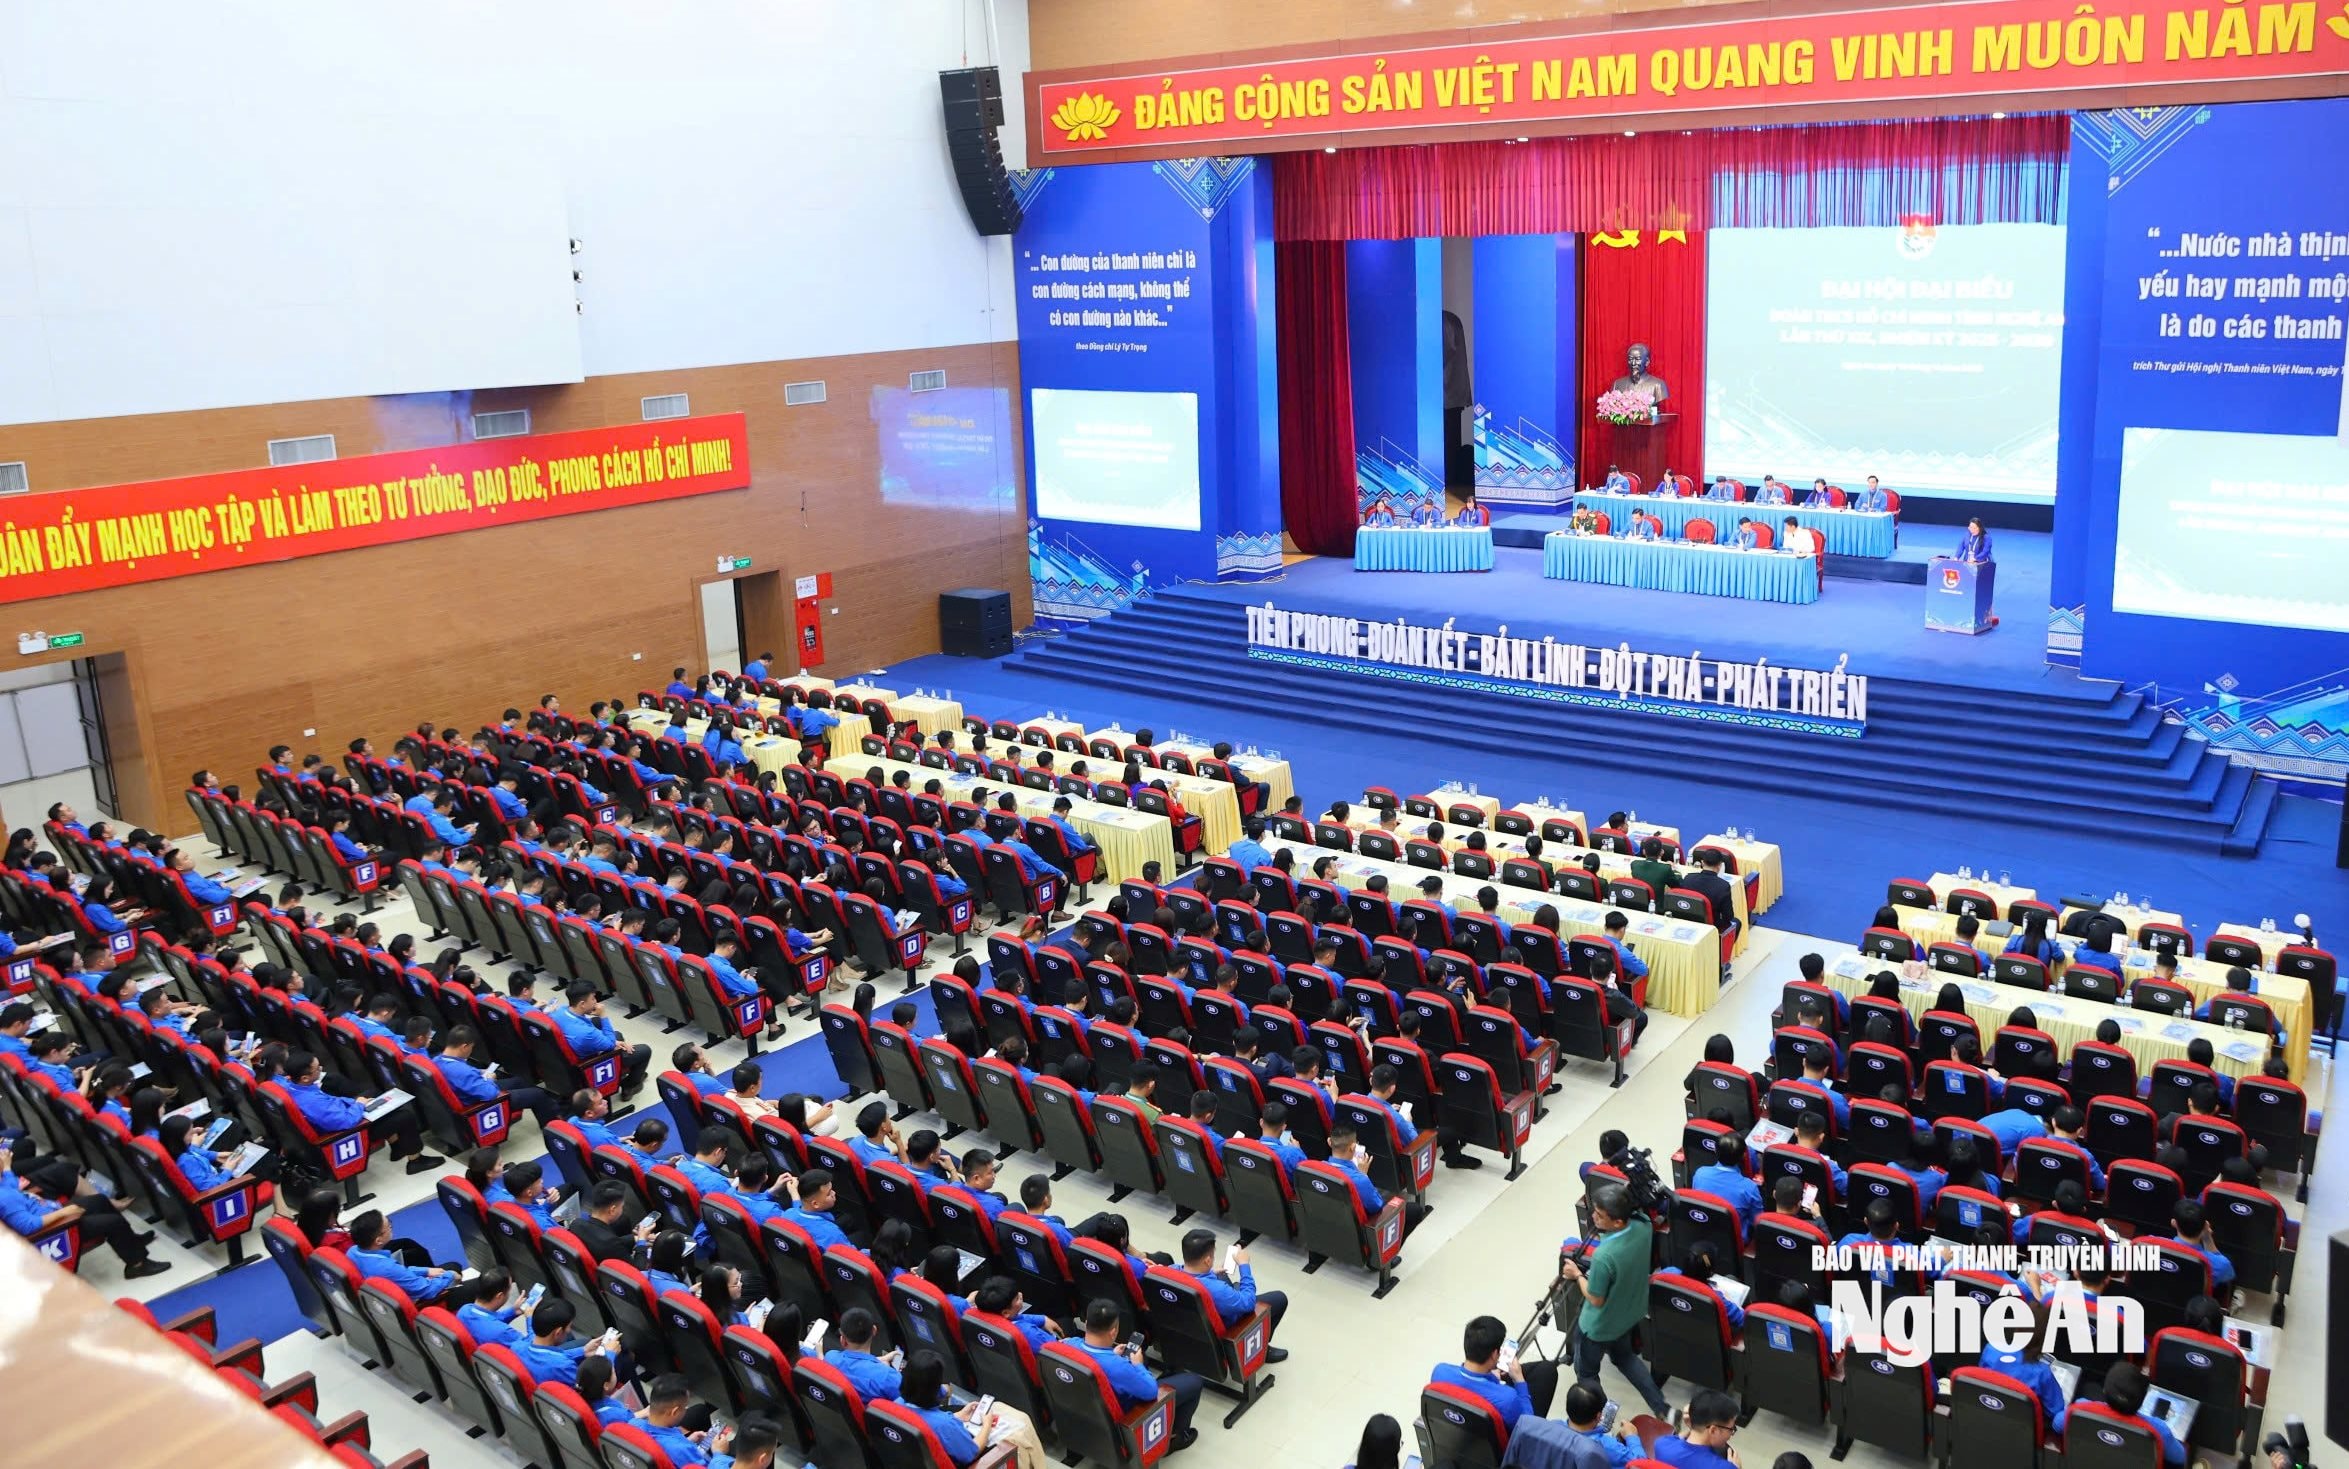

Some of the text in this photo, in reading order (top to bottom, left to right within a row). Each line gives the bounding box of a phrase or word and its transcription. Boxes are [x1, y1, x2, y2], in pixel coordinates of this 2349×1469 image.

[1134, 0, 2315, 130] ĐẢNG CỘNG SẢN VIỆT NAM QUANG VINH MUÔN NĂM
[2247, 232, 2292, 257] nhà
[2300, 232, 2349, 262] thịn
[1040, 254, 1059, 272] Con
[1060, 254, 1090, 272] đường
[1092, 252, 1110, 270] của
[1112, 253, 1140, 270] thanh
[1142, 252, 1164, 270] niên
[1167, 249, 1183, 269] chỉ
[1186, 251, 1196, 269] là
[1032, 284, 1050, 299] con
[1051, 282, 1080, 300] đường
[1082, 282, 1105, 298] cách
[1140, 281, 1171, 299] không
[1173, 277, 1191, 298] thể
[2138, 269, 2349, 303] yếu hay mạnh mộ
[1049, 309, 1062, 326] có
[1063, 312, 1080, 326] con
[1082, 310, 1111, 328] đường
[1114, 310, 1132, 326] nào
[2159, 313, 2342, 339] là do các thanh
[2223, 363, 2250, 373] Thanh
[2251, 363, 2270, 374] niên
[2316, 365, 2339, 376] ngày
[44, 505, 93, 570] ĐẨY
[95, 512, 168, 569] MẠNH
[168, 506, 215, 560] HỌC
[216, 494, 256, 552] TẬP
[258, 488, 289, 538] VÀ
[289, 485, 334, 535] LÀM
[334, 484, 382, 528] THEO
[383, 476, 408, 521] TƯ
[410, 464, 473, 516] TƯỞNG,
[472, 466, 507, 514] ĐẠO
[509, 456, 548, 503] ĐỨC,
[548, 455, 601, 497] PHONG
[602, 445, 642, 489] CÁCH
[643, 436, 664, 482] HỒ
[665, 437, 690, 478] CHÍ
[691, 439, 732, 476] MINH!
[1246, 601, 1289, 649] TIÊN
[1426, 616, 1468, 672] KẾT
[1480, 625, 1528, 681] BẢN
[1600, 642, 1648, 700] ĐỘT
[1651, 650, 1702, 702] PHÁ
[1717, 657, 1782, 711] PHÁT
[1788, 653, 1867, 721] TRIỂN
[602, 810, 612, 821] C
[360, 866, 372, 881] F
[1042, 886, 1051, 899] B
[214, 907, 230, 924] F1
[957, 906, 965, 920] C
[114, 934, 129, 950] G
[908, 940, 917, 954] D
[14, 962, 31, 981] H
[810, 964, 820, 977] E
[746, 1006, 756, 1020] F
[1622, 1028, 1630, 1042] B
[597, 1065, 612, 1082] F1
[1541, 1059, 1548, 1074] C
[483, 1112, 498, 1129] G
[1520, 1110, 1527, 1125] D
[339, 1142, 356, 1160] H
[1421, 1152, 1428, 1170] E
[1388, 1223, 1396, 1242] F
[41, 1238, 63, 1257] K
[1150, 1417, 1162, 1441] G
